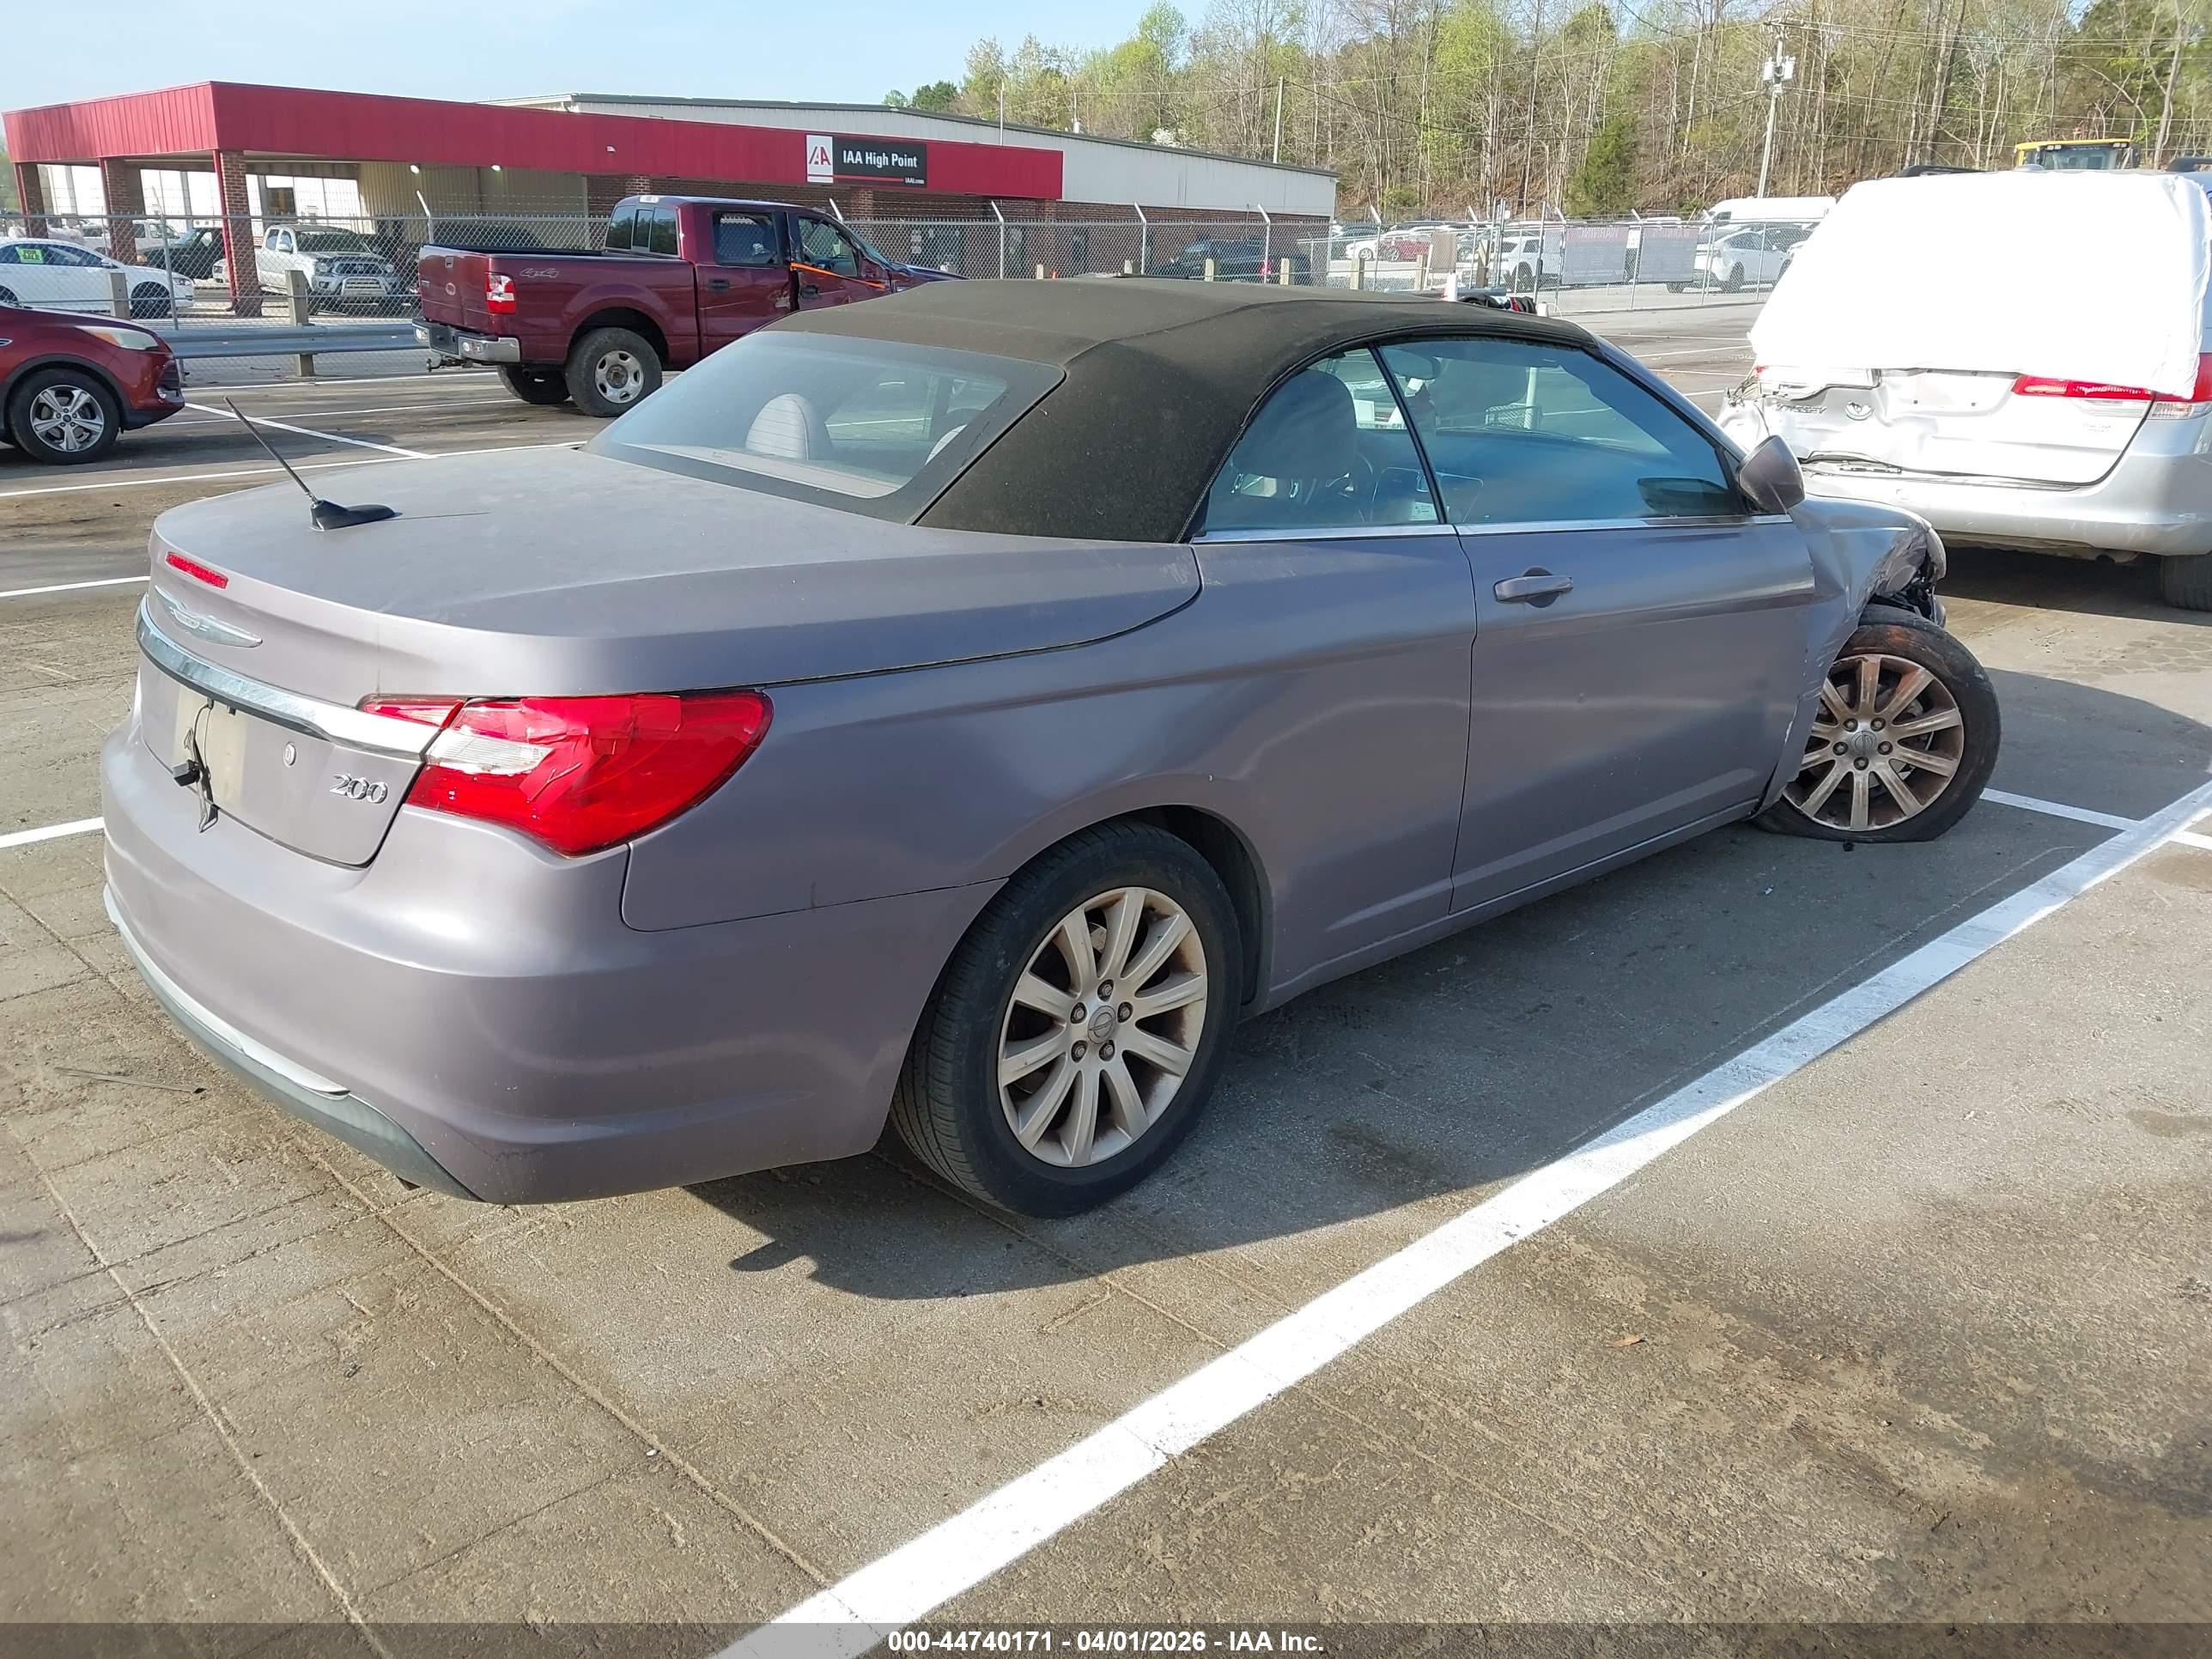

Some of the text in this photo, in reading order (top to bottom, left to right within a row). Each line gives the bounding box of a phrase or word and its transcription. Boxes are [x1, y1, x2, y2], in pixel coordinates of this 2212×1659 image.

[843, 149, 918, 168] IAA High Point
[329, 774, 388, 804] 200
